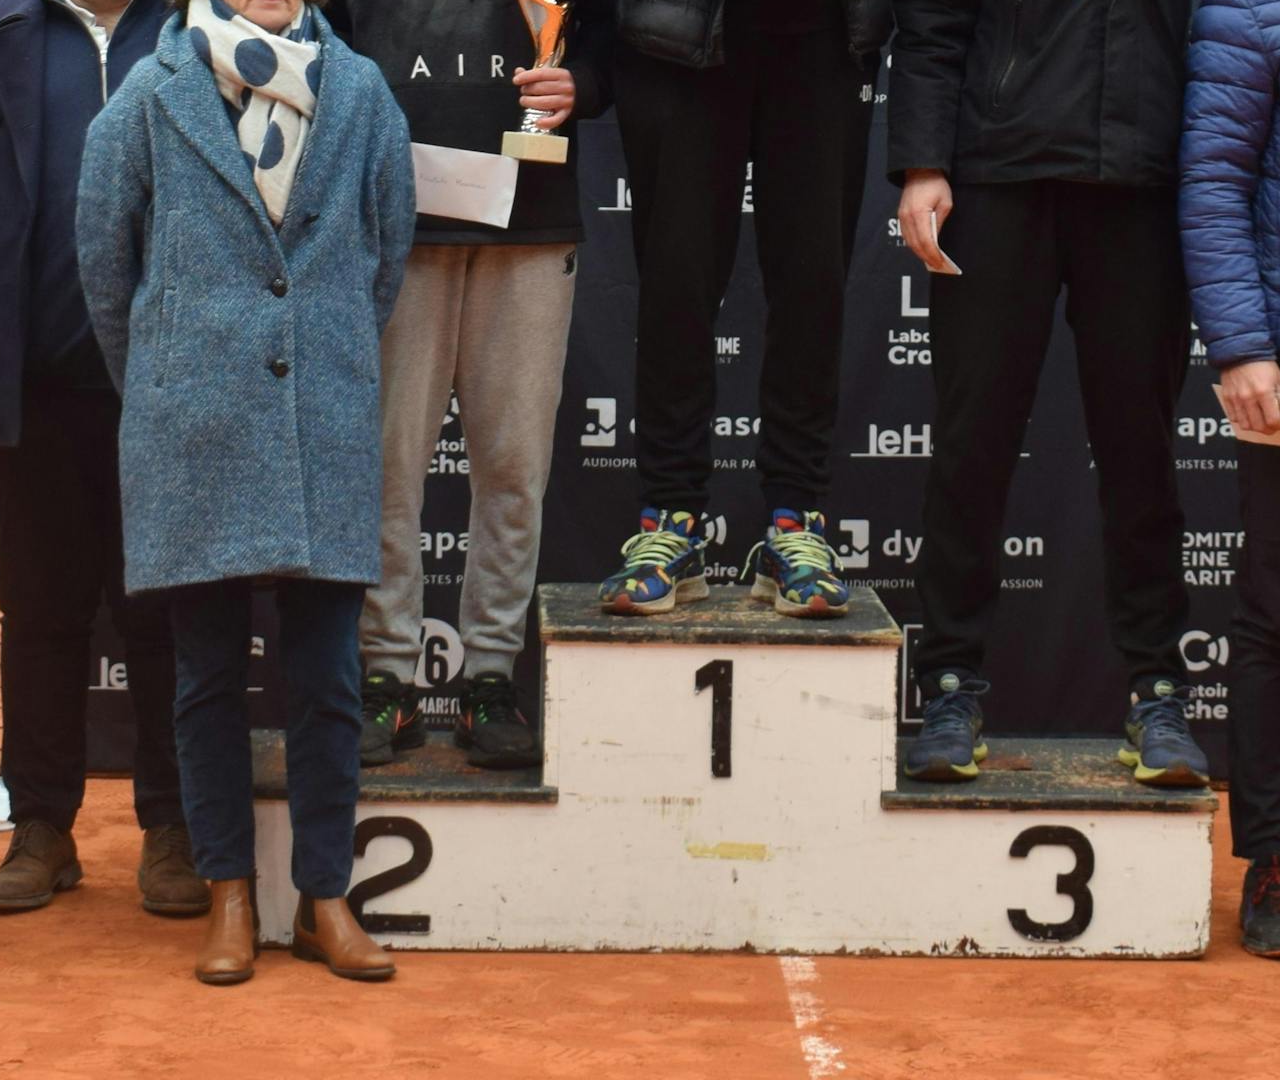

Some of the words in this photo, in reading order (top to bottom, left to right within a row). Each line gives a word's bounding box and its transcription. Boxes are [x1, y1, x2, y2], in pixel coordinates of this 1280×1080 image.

[410, 53, 505, 79] AIR
[1000, 579, 1044, 589] ASSION
[1182, 551, 1229, 567] EINE
[695, 658, 734, 779] 1
[348, 816, 434, 936] 2
[1006, 825, 1095, 942] 3
